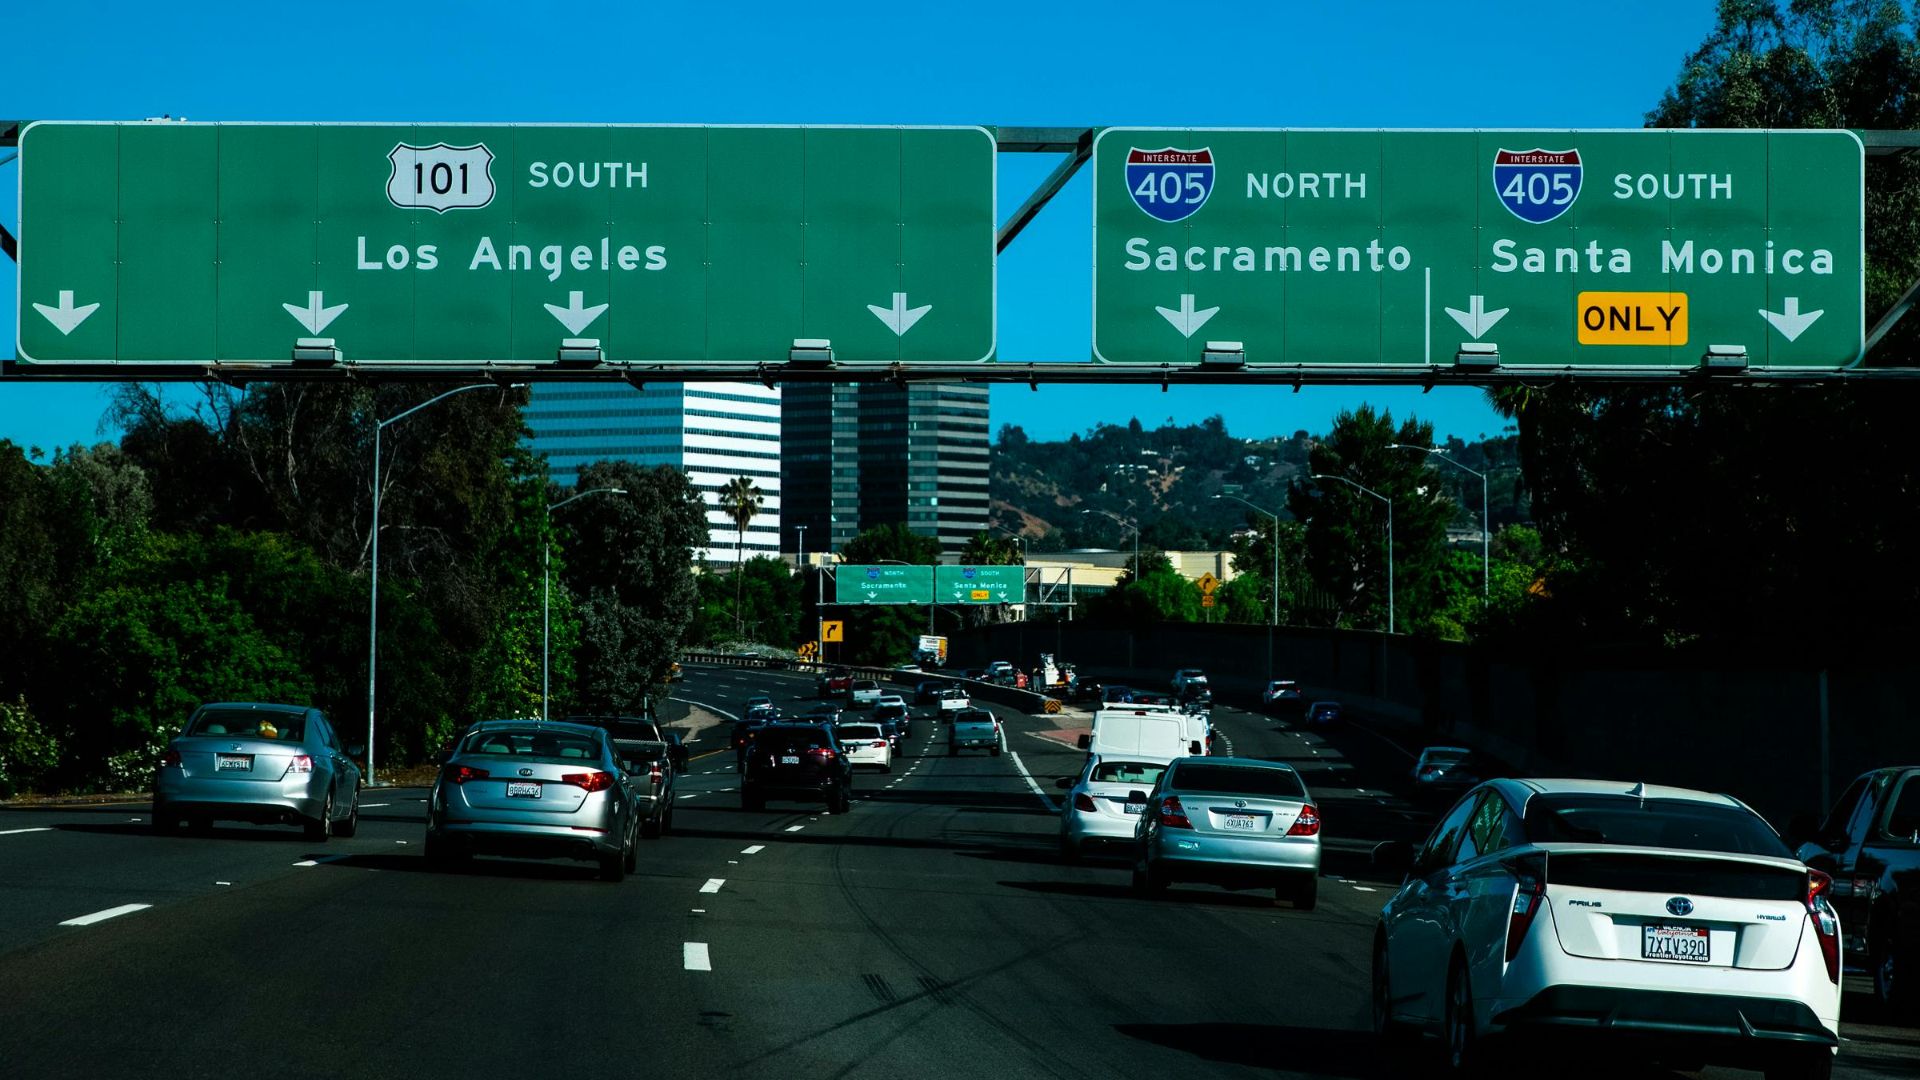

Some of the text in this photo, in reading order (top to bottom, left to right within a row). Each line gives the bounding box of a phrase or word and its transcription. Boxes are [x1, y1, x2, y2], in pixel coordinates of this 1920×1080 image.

[1143, 154, 1197, 163] INTERSTATE
[1511, 155, 1565, 164] INTERSTATE
[414, 162, 648, 195] 101 SOUTH
[1135, 172, 1366, 204] 405 NORTH
[1503, 172, 1733, 205] 405 SOUTH
[357, 236, 667, 282] Los Angeles
[1124, 237, 1411, 272] Sacramento
[1491, 238, 1833, 274] Santa Monica
[1584, 305, 1681, 331] ONLY
[861, 581, 907, 589] Sacramento
[954, 581, 1007, 589] Santa Monica
[1568, 899, 1602, 908] PRIUS
[1647, 935, 1705, 956] 7XIV390
